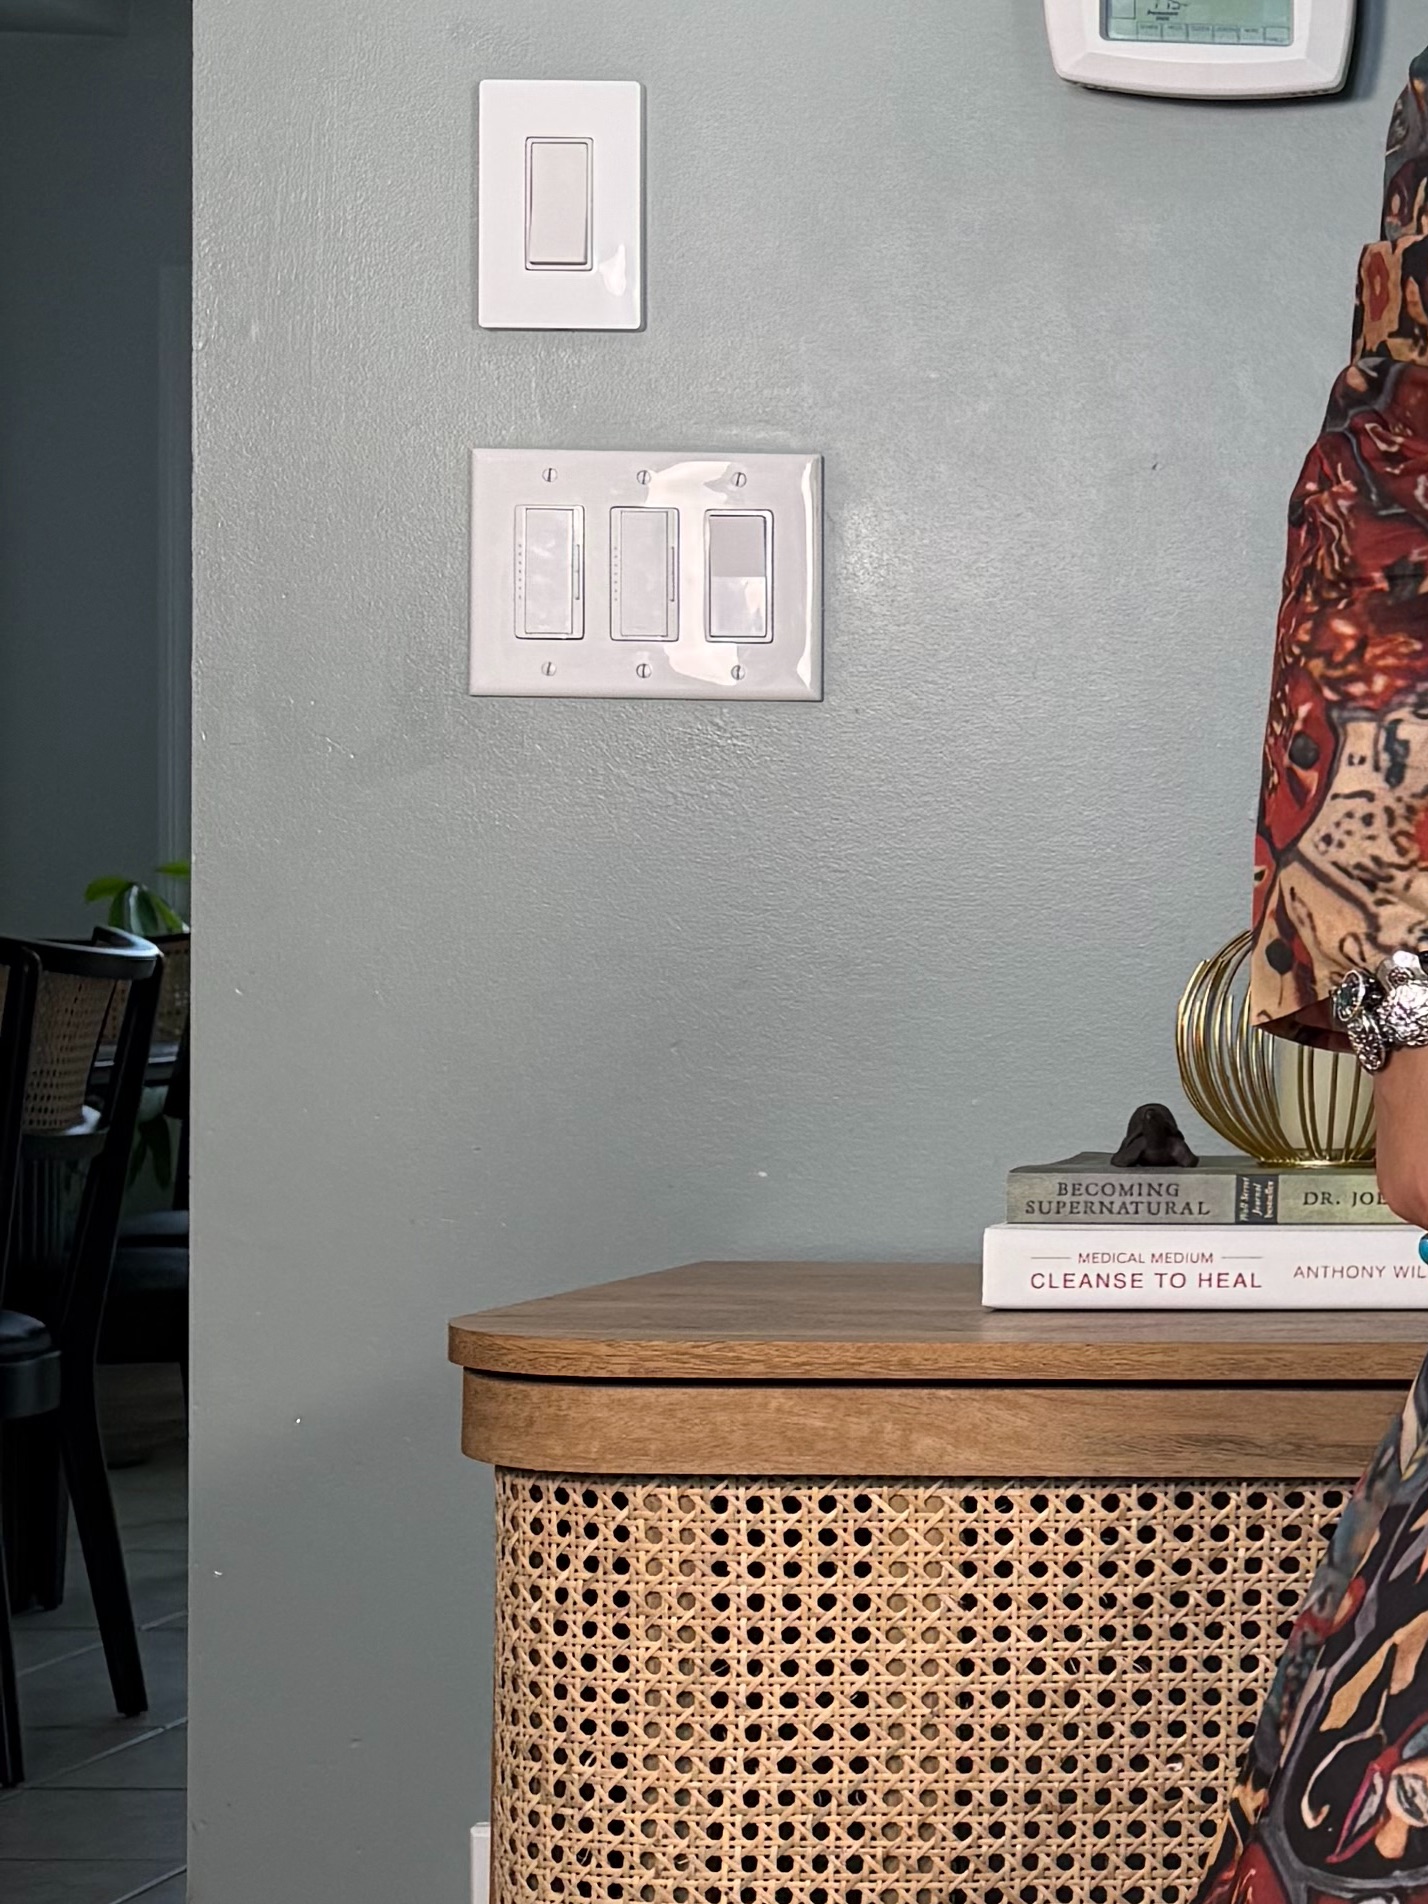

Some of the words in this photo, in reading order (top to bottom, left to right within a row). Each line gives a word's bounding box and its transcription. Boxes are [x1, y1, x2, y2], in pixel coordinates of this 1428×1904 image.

[1057, 1182, 1180, 1197] BECOMING
[1252, 1182, 1263, 1216] Journal
[1303, 1191, 1340, 1206] DR.
[1025, 1200, 1212, 1216] SUPERNATURAL
[1077, 1252, 1145, 1265] MEDICAL
[1150, 1252, 1214, 1265] MEDIUM
[1293, 1265, 1386, 1279] ANTHONY
[1030, 1272, 1144, 1290] CLEANSE
[1154, 1272, 1187, 1289] TO
[1198, 1272, 1263, 1289] HEAL
